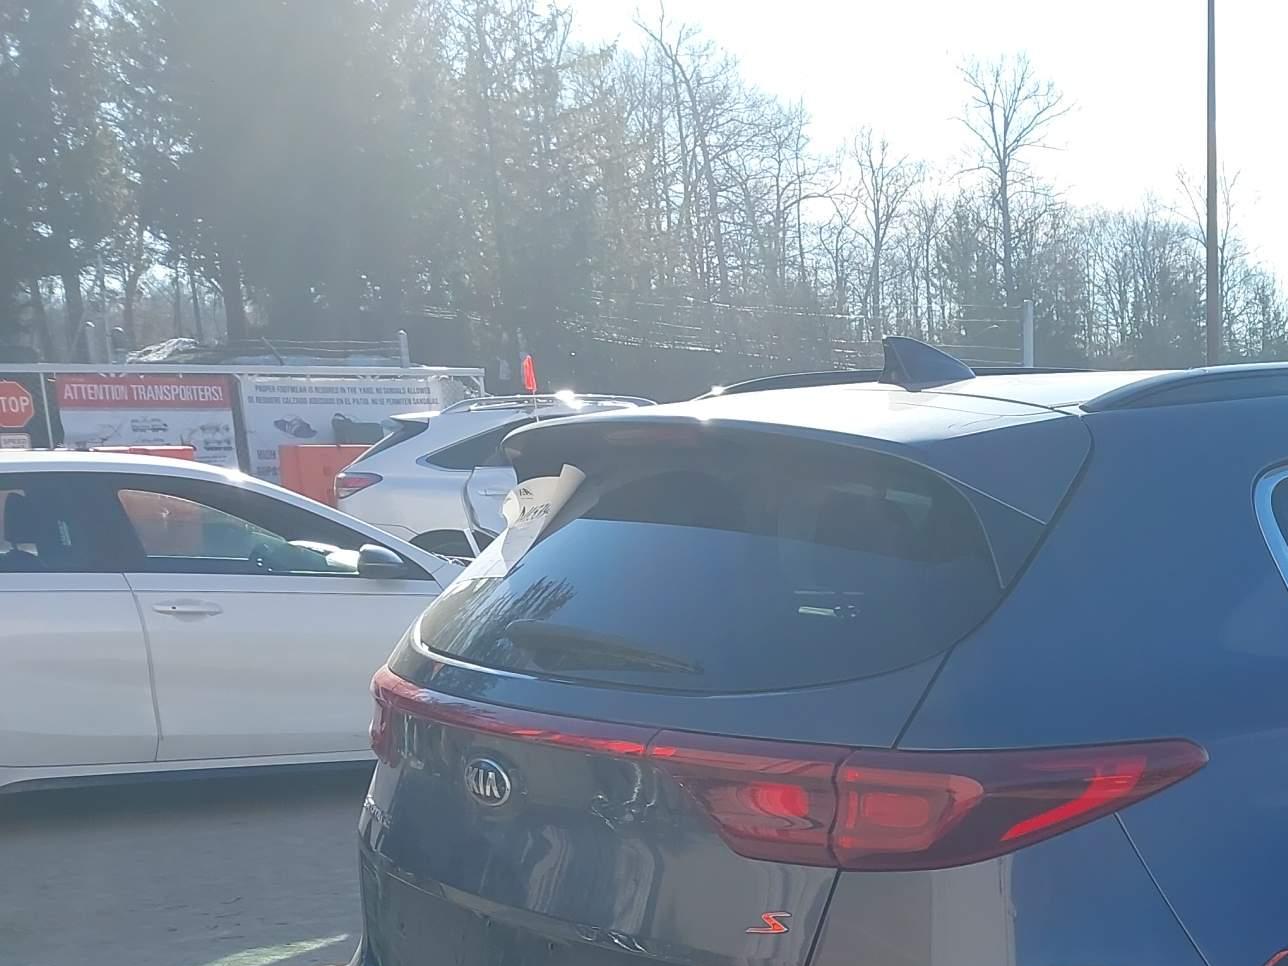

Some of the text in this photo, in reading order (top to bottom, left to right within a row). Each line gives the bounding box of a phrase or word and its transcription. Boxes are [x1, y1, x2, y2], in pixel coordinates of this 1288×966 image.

[64, 384, 223, 400] ATTENTION TRANSPORTERS!
[0, 396, 30, 413] TOP
[745, 911, 792, 934] S
